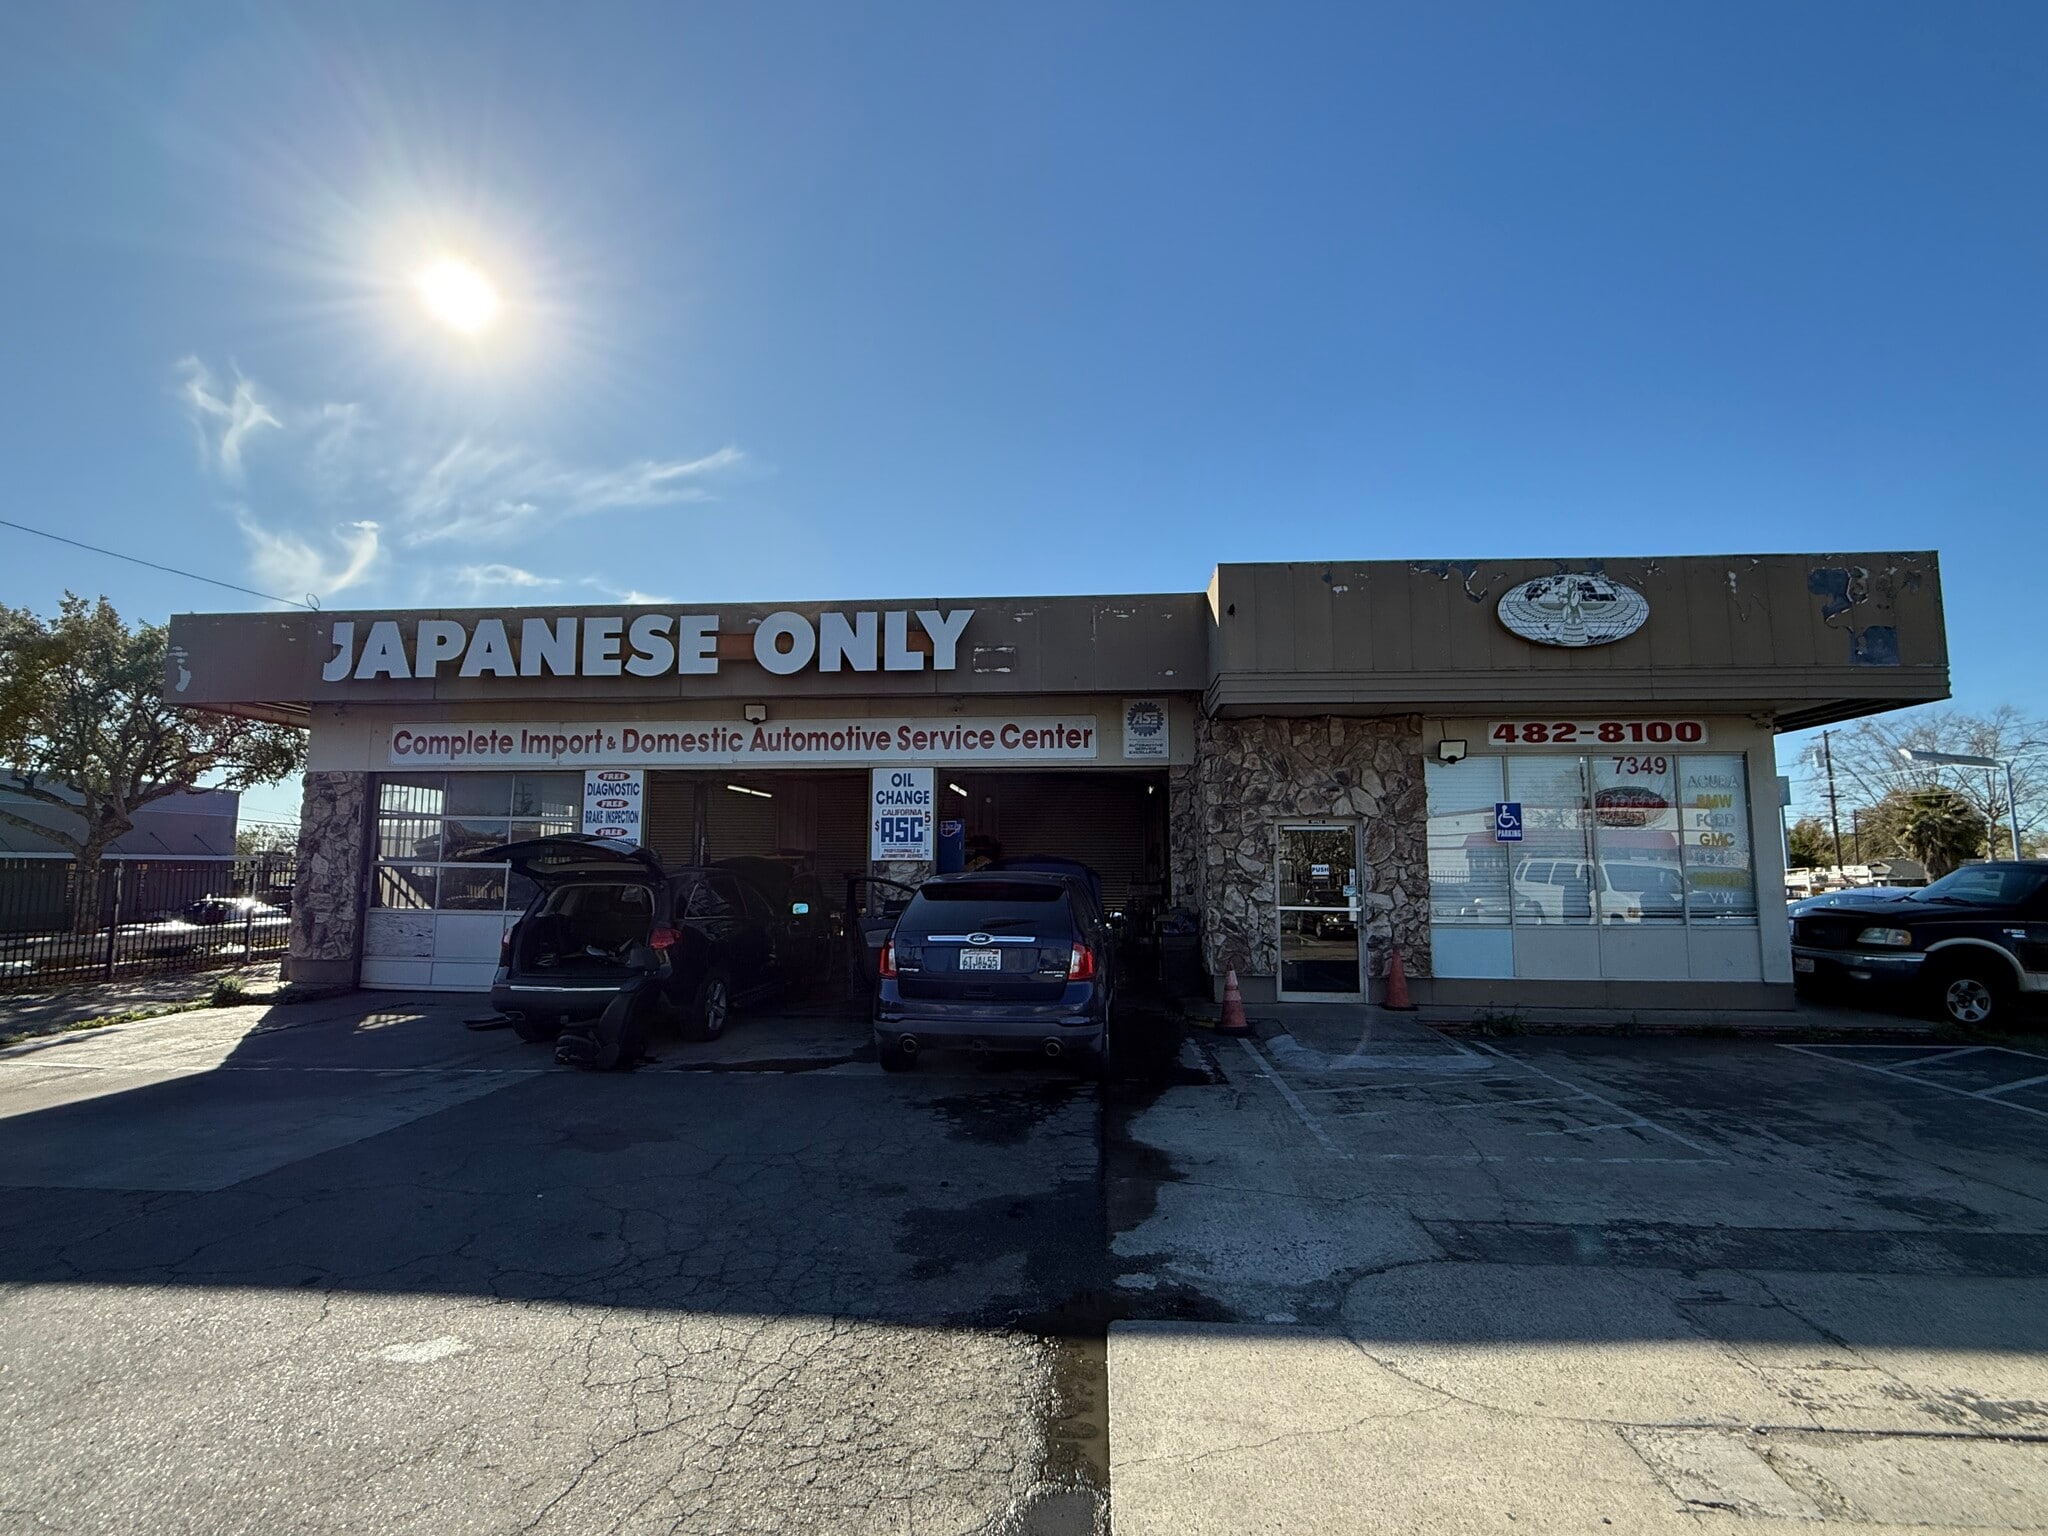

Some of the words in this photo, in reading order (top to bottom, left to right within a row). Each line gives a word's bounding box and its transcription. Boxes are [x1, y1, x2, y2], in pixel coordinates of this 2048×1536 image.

[322, 614, 719, 682] JAPANESE
[753, 609, 975, 675] ONLY
[1132, 711, 1158, 724] ASE
[1493, 721, 1702, 743] 482-8100
[393, 730, 514, 760] Complete
[521, 729, 602, 759] Import
[606, 736, 616, 750] &
[622, 727, 744, 753] Domestic
[750, 726, 892, 752] Automotive
[897, 725, 995, 750] Service
[1000, 723, 1093, 749] Center
[1612, 756, 1667, 775] 7349
[891, 773, 914, 787] OIL
[1688, 775, 1739, 788] ACURA
[587, 783, 640, 796] DIAGNOSTIC
[876, 790, 930, 805] CHANGE
[1696, 794, 1733, 808] BMW
[585, 811, 603, 824] BRAKE
[606, 811, 639, 824] INSPECTION
[881, 817, 923, 842] ASC
[1498, 829, 1521, 838] PARKING
[1699, 833, 1735, 848] GMC
